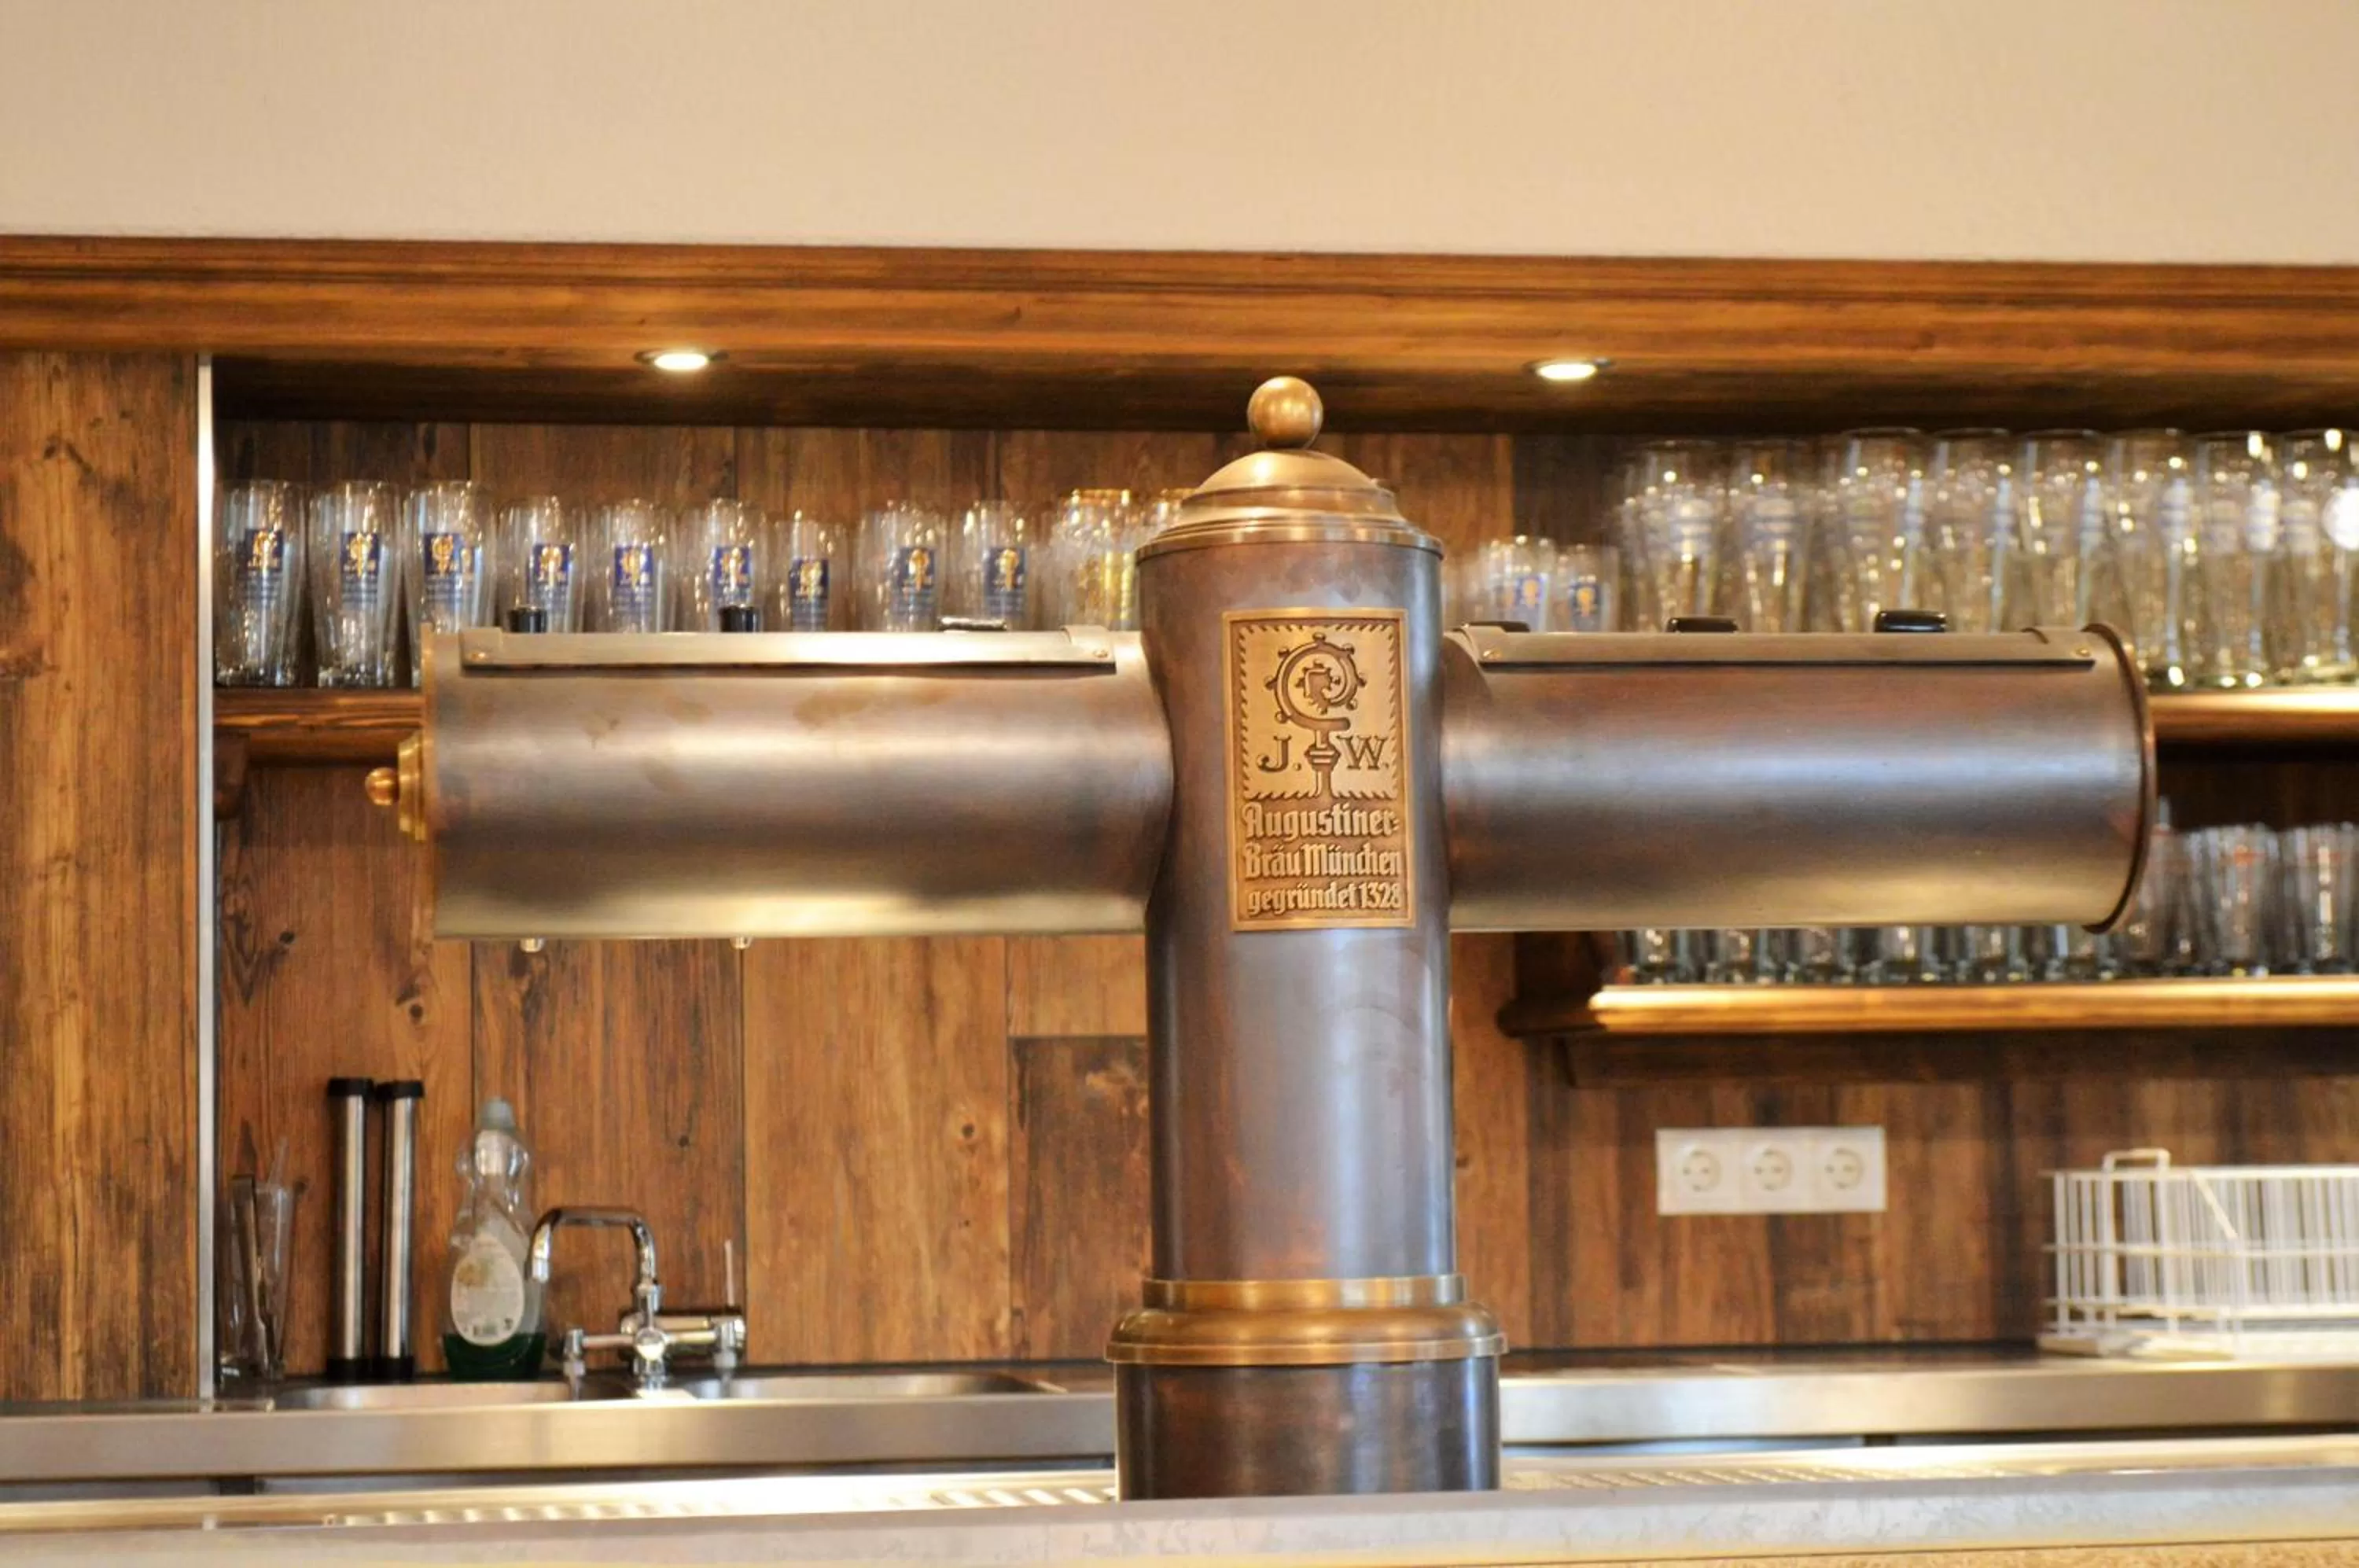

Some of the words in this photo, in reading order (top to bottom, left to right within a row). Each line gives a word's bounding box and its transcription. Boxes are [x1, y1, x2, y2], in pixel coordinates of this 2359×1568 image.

[1244, 842, 1301, 878] Bräu
[1302, 842, 1400, 878] München
[1246, 882, 1358, 917] gegründet
[1359, 882, 1402, 911] 1328
